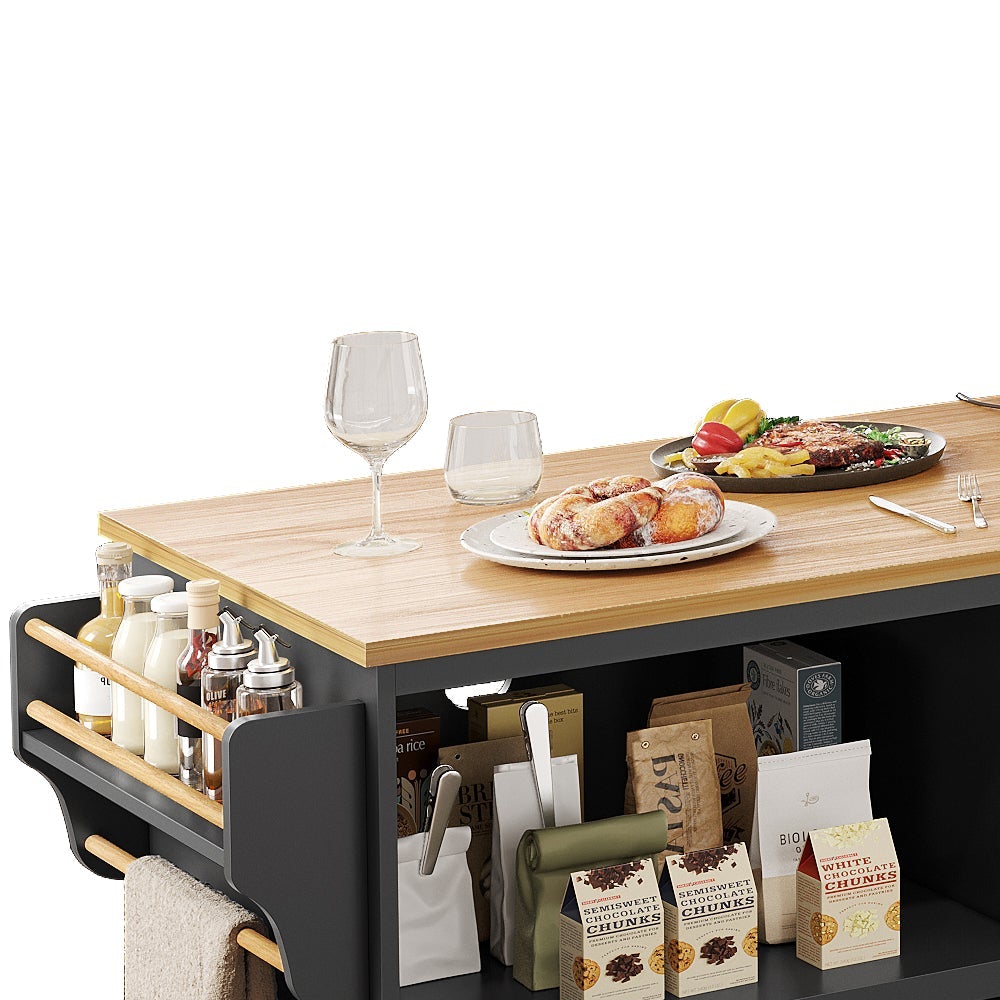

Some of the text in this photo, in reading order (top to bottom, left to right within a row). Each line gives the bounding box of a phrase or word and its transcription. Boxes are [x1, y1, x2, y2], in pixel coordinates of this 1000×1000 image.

[206, 689, 227, 701] OLIVE
[406, 738, 426, 752] rice
[821, 856, 872, 872] WHITE
[823, 861, 896, 881] CHOCOLATE
[678, 879, 751, 899] SEMISWEET
[824, 870, 897, 891] CHUNKS
[583, 895, 658, 916] SEMISWEET
[680, 887, 754, 907] CHOCOLATE
[681, 896, 755, 917] CHUNKS
[585, 904, 660, 924] CHOCOLATE
[586, 913, 661, 934] CHUNKS
